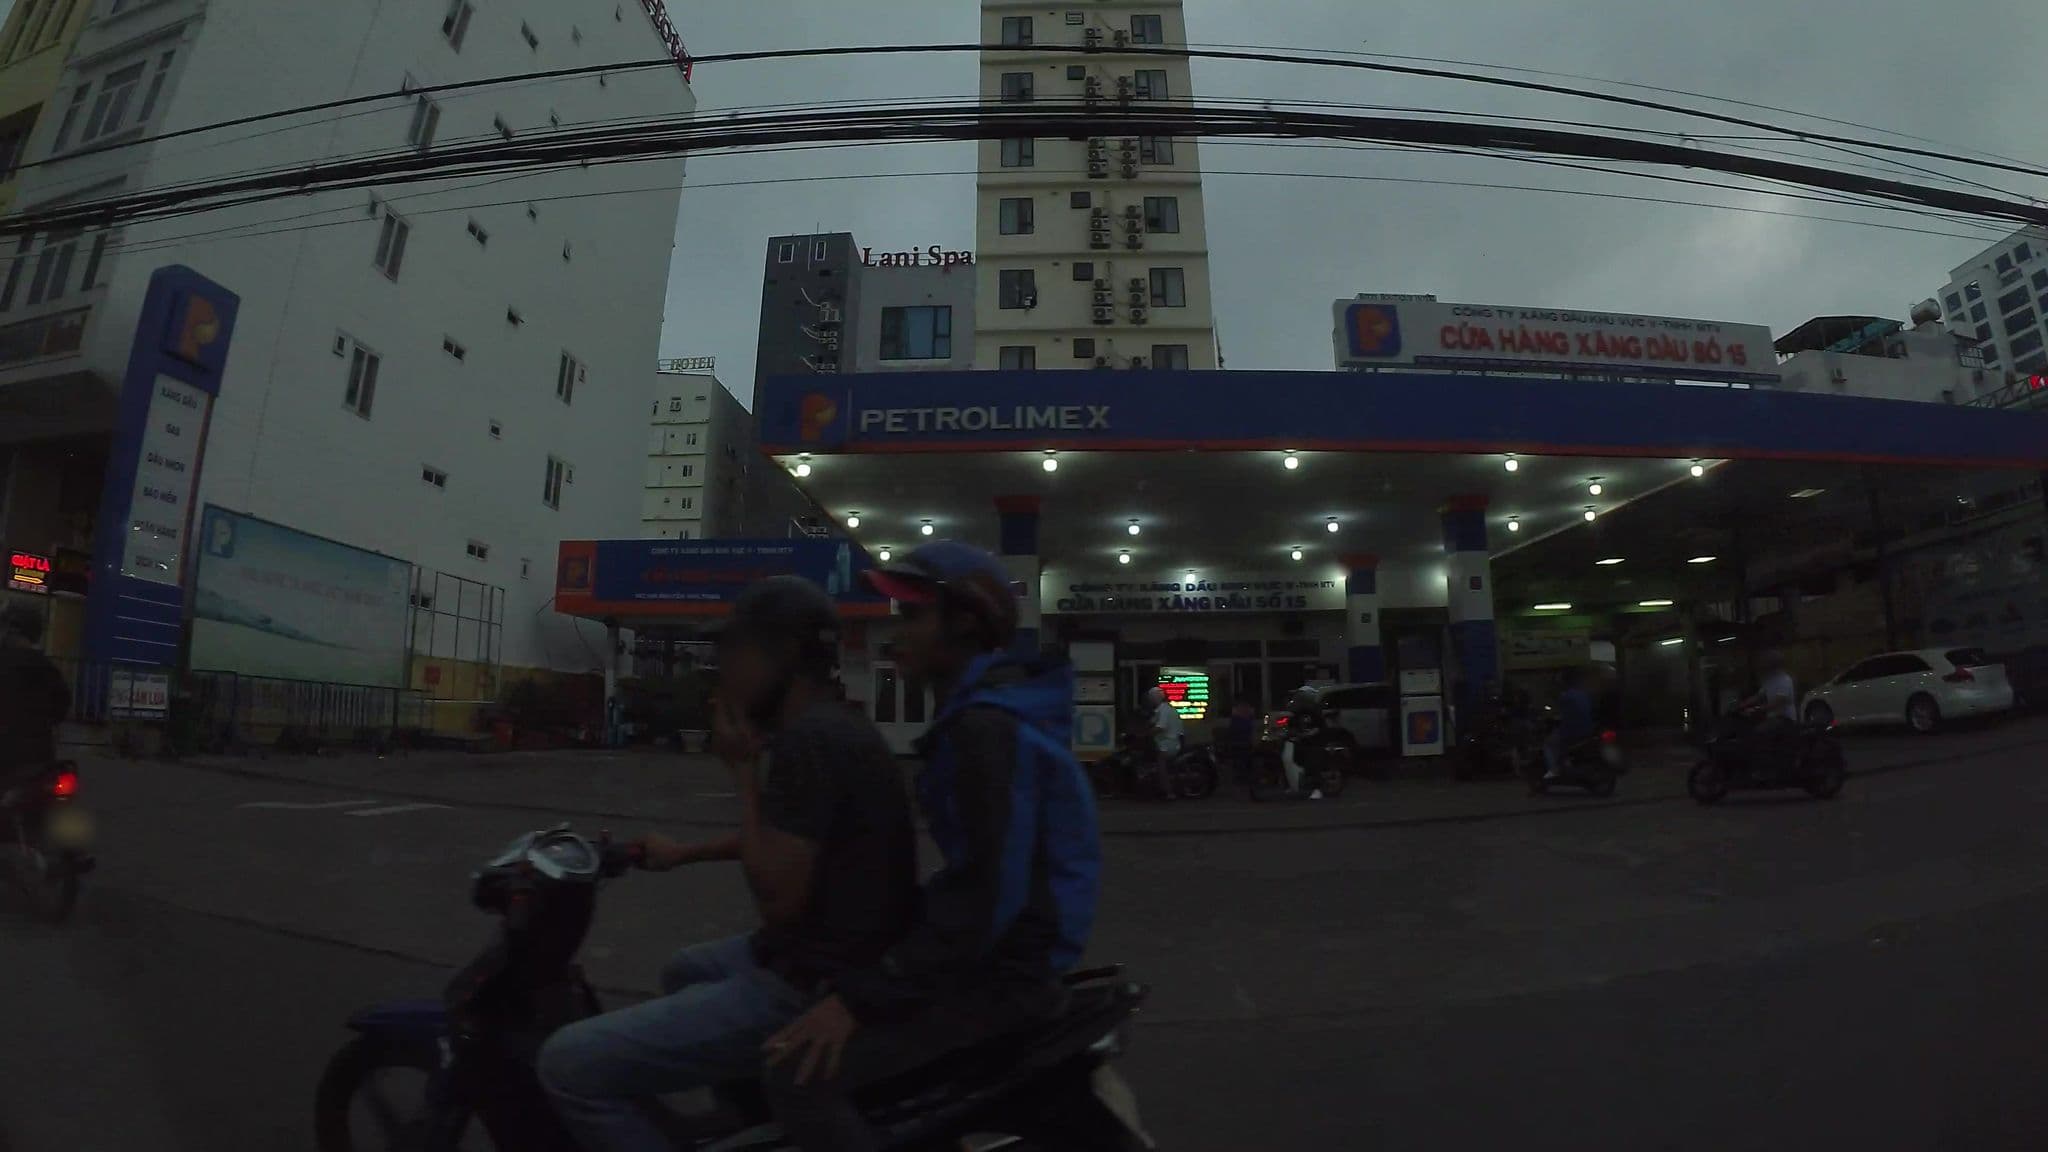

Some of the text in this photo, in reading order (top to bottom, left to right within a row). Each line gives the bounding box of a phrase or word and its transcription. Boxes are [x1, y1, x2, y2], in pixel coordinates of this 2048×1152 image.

[862, 245, 976, 272] Lani Spa
[1499, 323, 1570, 356] HÀNG
[1726, 343, 1747, 366] 15
[859, 406, 1111, 433] PETROLIMEX
[1185, 579, 1216, 592] DẦU
[1158, 594, 1209, 611] XĂNG
[1255, 593, 1284, 609] SỐ
[1286, 596, 1307, 609] 15
